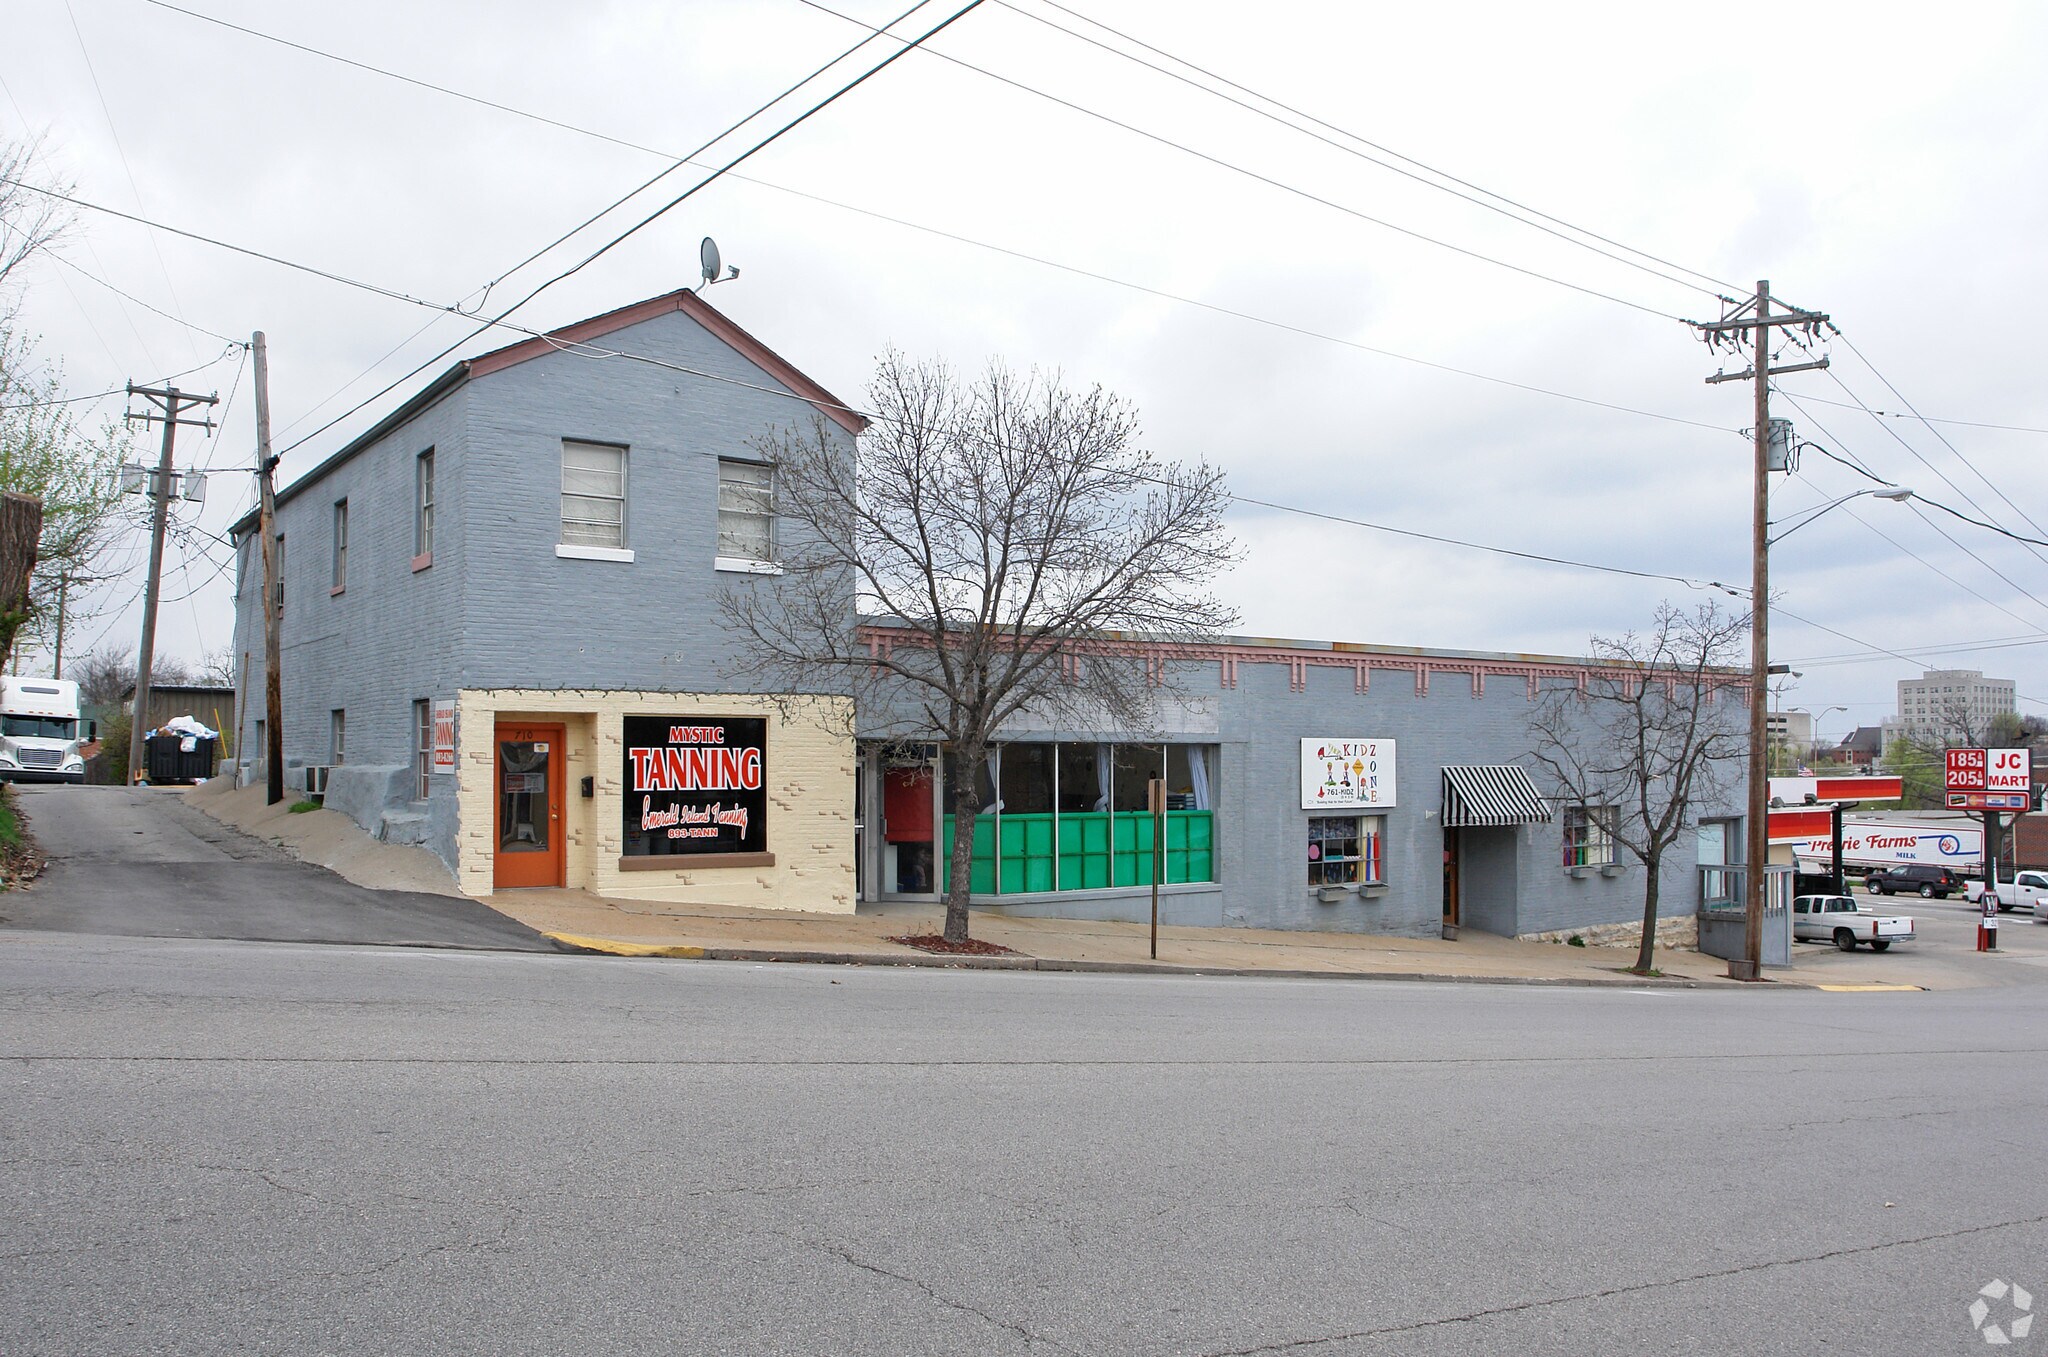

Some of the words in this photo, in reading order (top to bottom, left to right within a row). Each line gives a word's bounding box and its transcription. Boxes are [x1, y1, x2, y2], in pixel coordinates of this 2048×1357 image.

[514, 730, 533, 740] 710
[668, 726, 725, 744] MYSTIC
[1343, 744, 1376, 757] KIDZ
[1950, 752, 1977, 767] 185
[1995, 753, 2021, 769] JC
[629, 747, 761, 791] TANNING
[1948, 771, 1977, 786] 205
[1988, 775, 2028, 787] MART
[642, 794, 679, 831] Emerald
[680, 804, 711, 824] Island
[711, 801, 748, 840] Tanning
[667, 827, 719, 839] 893-TANN
[1865, 834, 1918, 849] Farms
[1895, 851, 1917, 859] MILK
